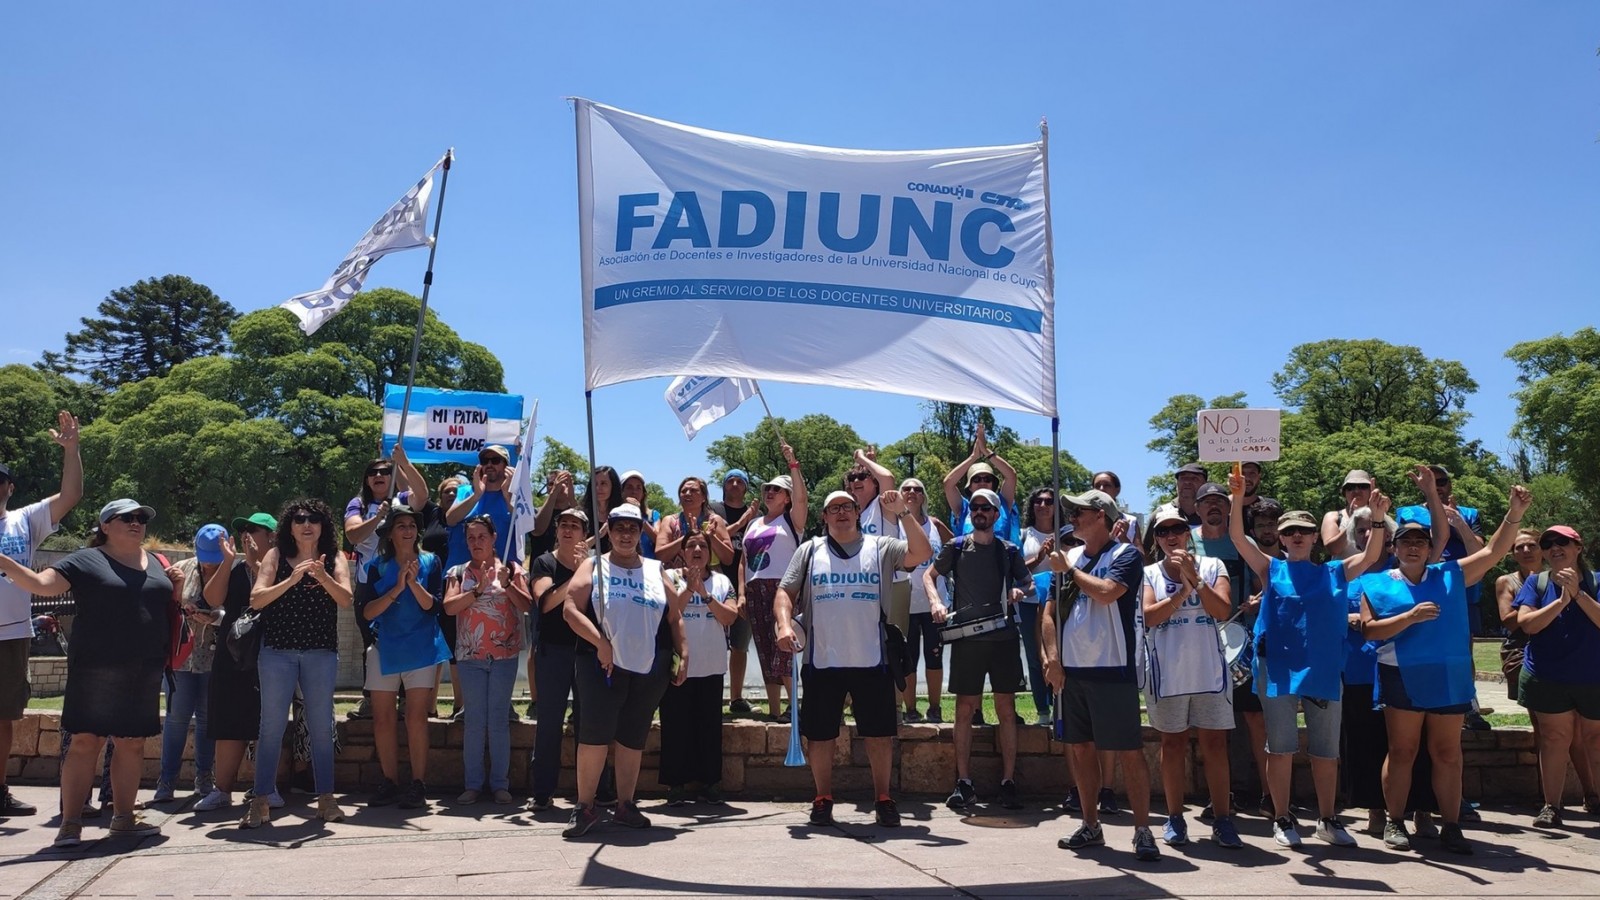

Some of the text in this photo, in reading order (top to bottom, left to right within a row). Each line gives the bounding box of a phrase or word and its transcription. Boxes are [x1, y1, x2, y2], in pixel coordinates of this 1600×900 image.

[615, 190, 1016, 269] FADIUNC
[599, 249, 1038, 290] Asociación de Docentes e Investigadores de la Universidad Nacional de Cuyo
[614, 284, 1013, 323] UN GREMIO AL SERVICIO DE LOS DOCENTES UNIVERSITARIOS
[433, 409, 448, 423] MI
[449, 425, 464, 436] NO
[427, 438, 486, 452] SE VENDE
[1233, 436, 1276, 444] dictadura
[811, 572, 881, 586] FADIUNC
